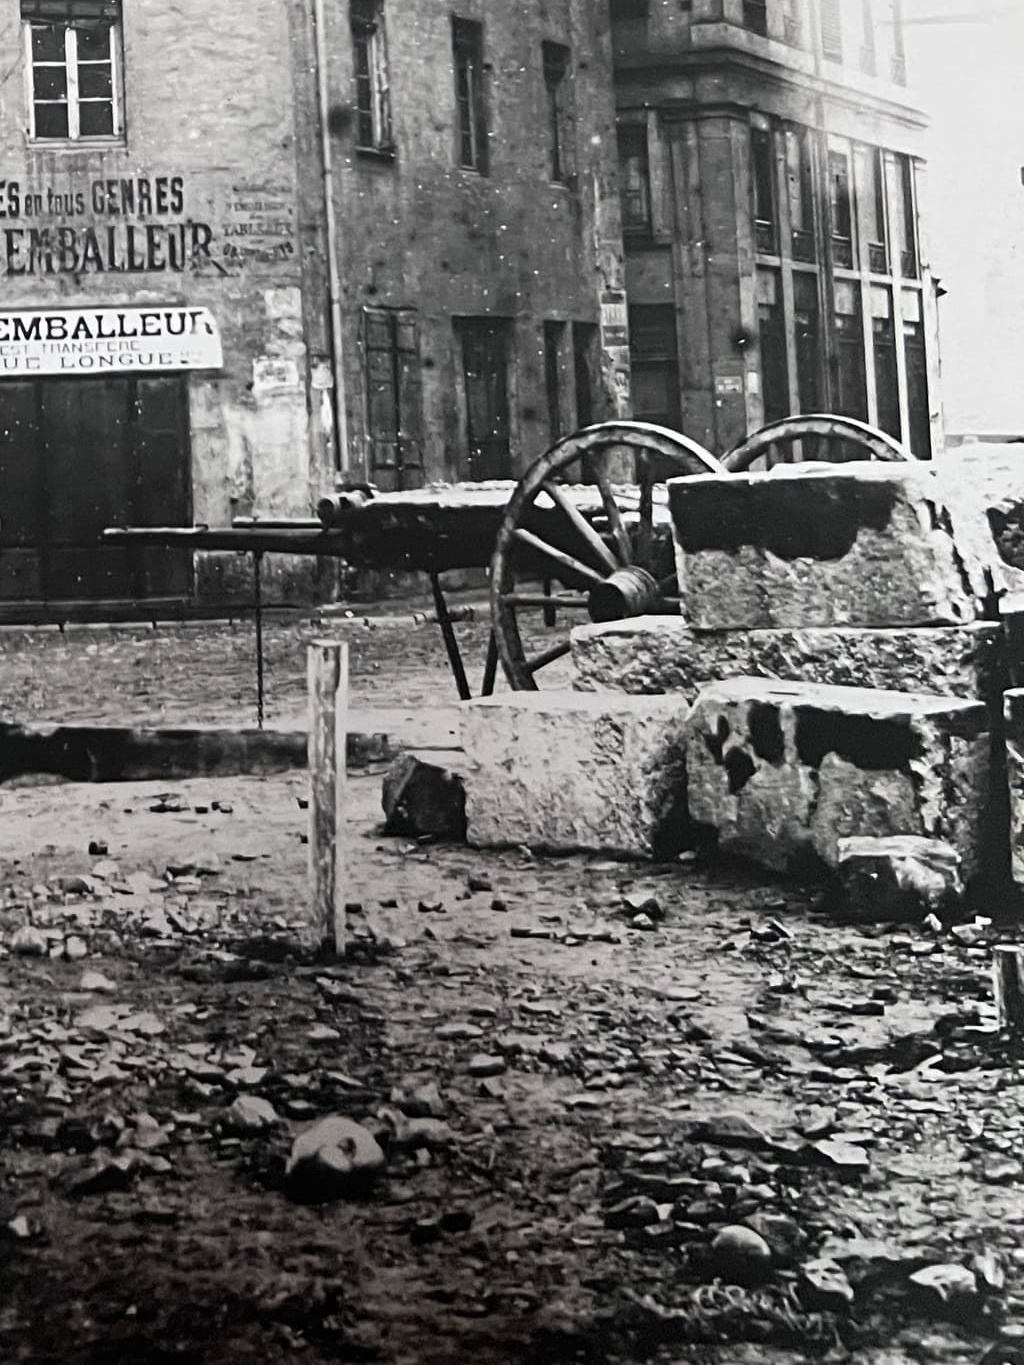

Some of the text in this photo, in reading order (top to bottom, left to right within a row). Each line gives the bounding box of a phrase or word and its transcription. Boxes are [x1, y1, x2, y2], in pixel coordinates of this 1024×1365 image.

[24, 193, 43, 216] en
[47, 187, 85, 216] tous
[92, 176, 184, 218] GENRES
[4, 220, 228, 277] EMBALLEUR
[0, 344, 29, 356] EST
[60, 352, 173, 369] LONGUE
